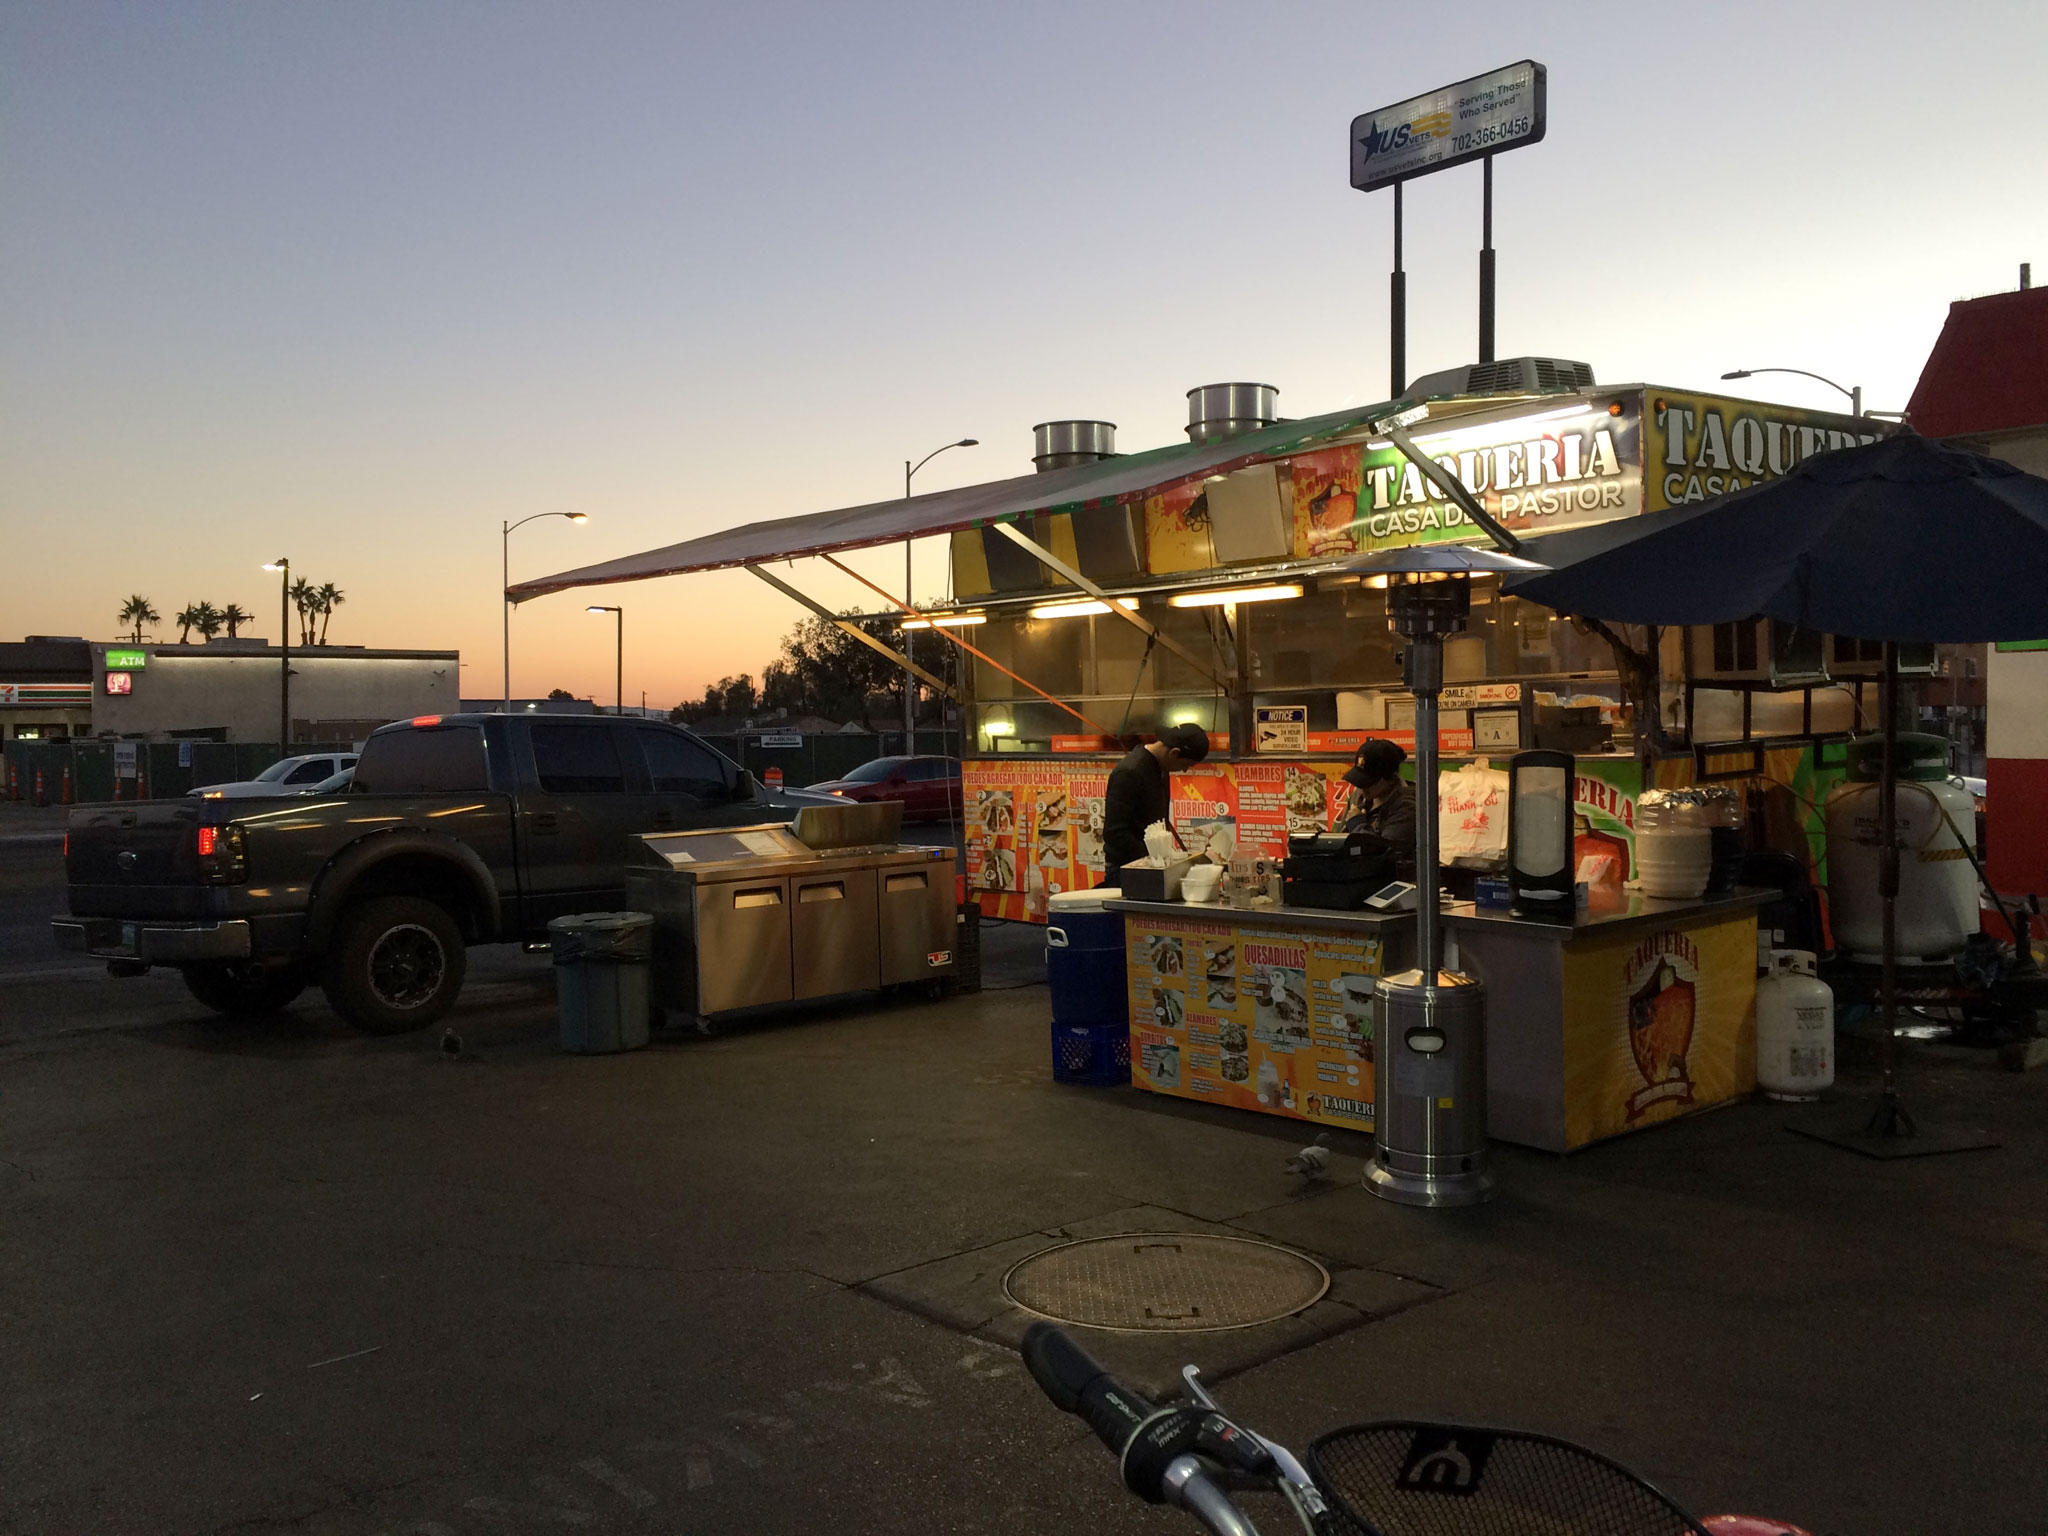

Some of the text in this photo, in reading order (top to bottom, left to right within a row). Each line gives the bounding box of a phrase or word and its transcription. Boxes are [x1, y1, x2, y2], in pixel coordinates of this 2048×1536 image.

[1497, 80, 1526, 95] Those
[1459, 107, 1481, 120] Who
[1451, 116, 1529, 153] 702-366-0456
[1370, 507, 1441, 538] CASA
[1502, 481, 1624, 520] PASTOR
[119, 656, 145, 666] ATM
[1444, 689, 1465, 699] SMILE
[1268, 711, 1294, 721] NOTICE
[963, 772, 985, 785] PUEDES
[1034, 773, 1047, 785] CAN
[1049, 773, 1063, 785] ADD
[1234, 766, 1281, 781] ALAMBRES
[1287, 767, 1296, 777] 14
[1174, 800, 1217, 818] BURRITOS
[1574, 776, 1635, 831] ERIA
[1288, 817, 1298, 828] 15
[1244, 944, 1307, 970] QUESADILLAS
[1624, 929, 1699, 986] TAQUERIA
[1186, 1012, 1218, 1026] ALAMBRES
